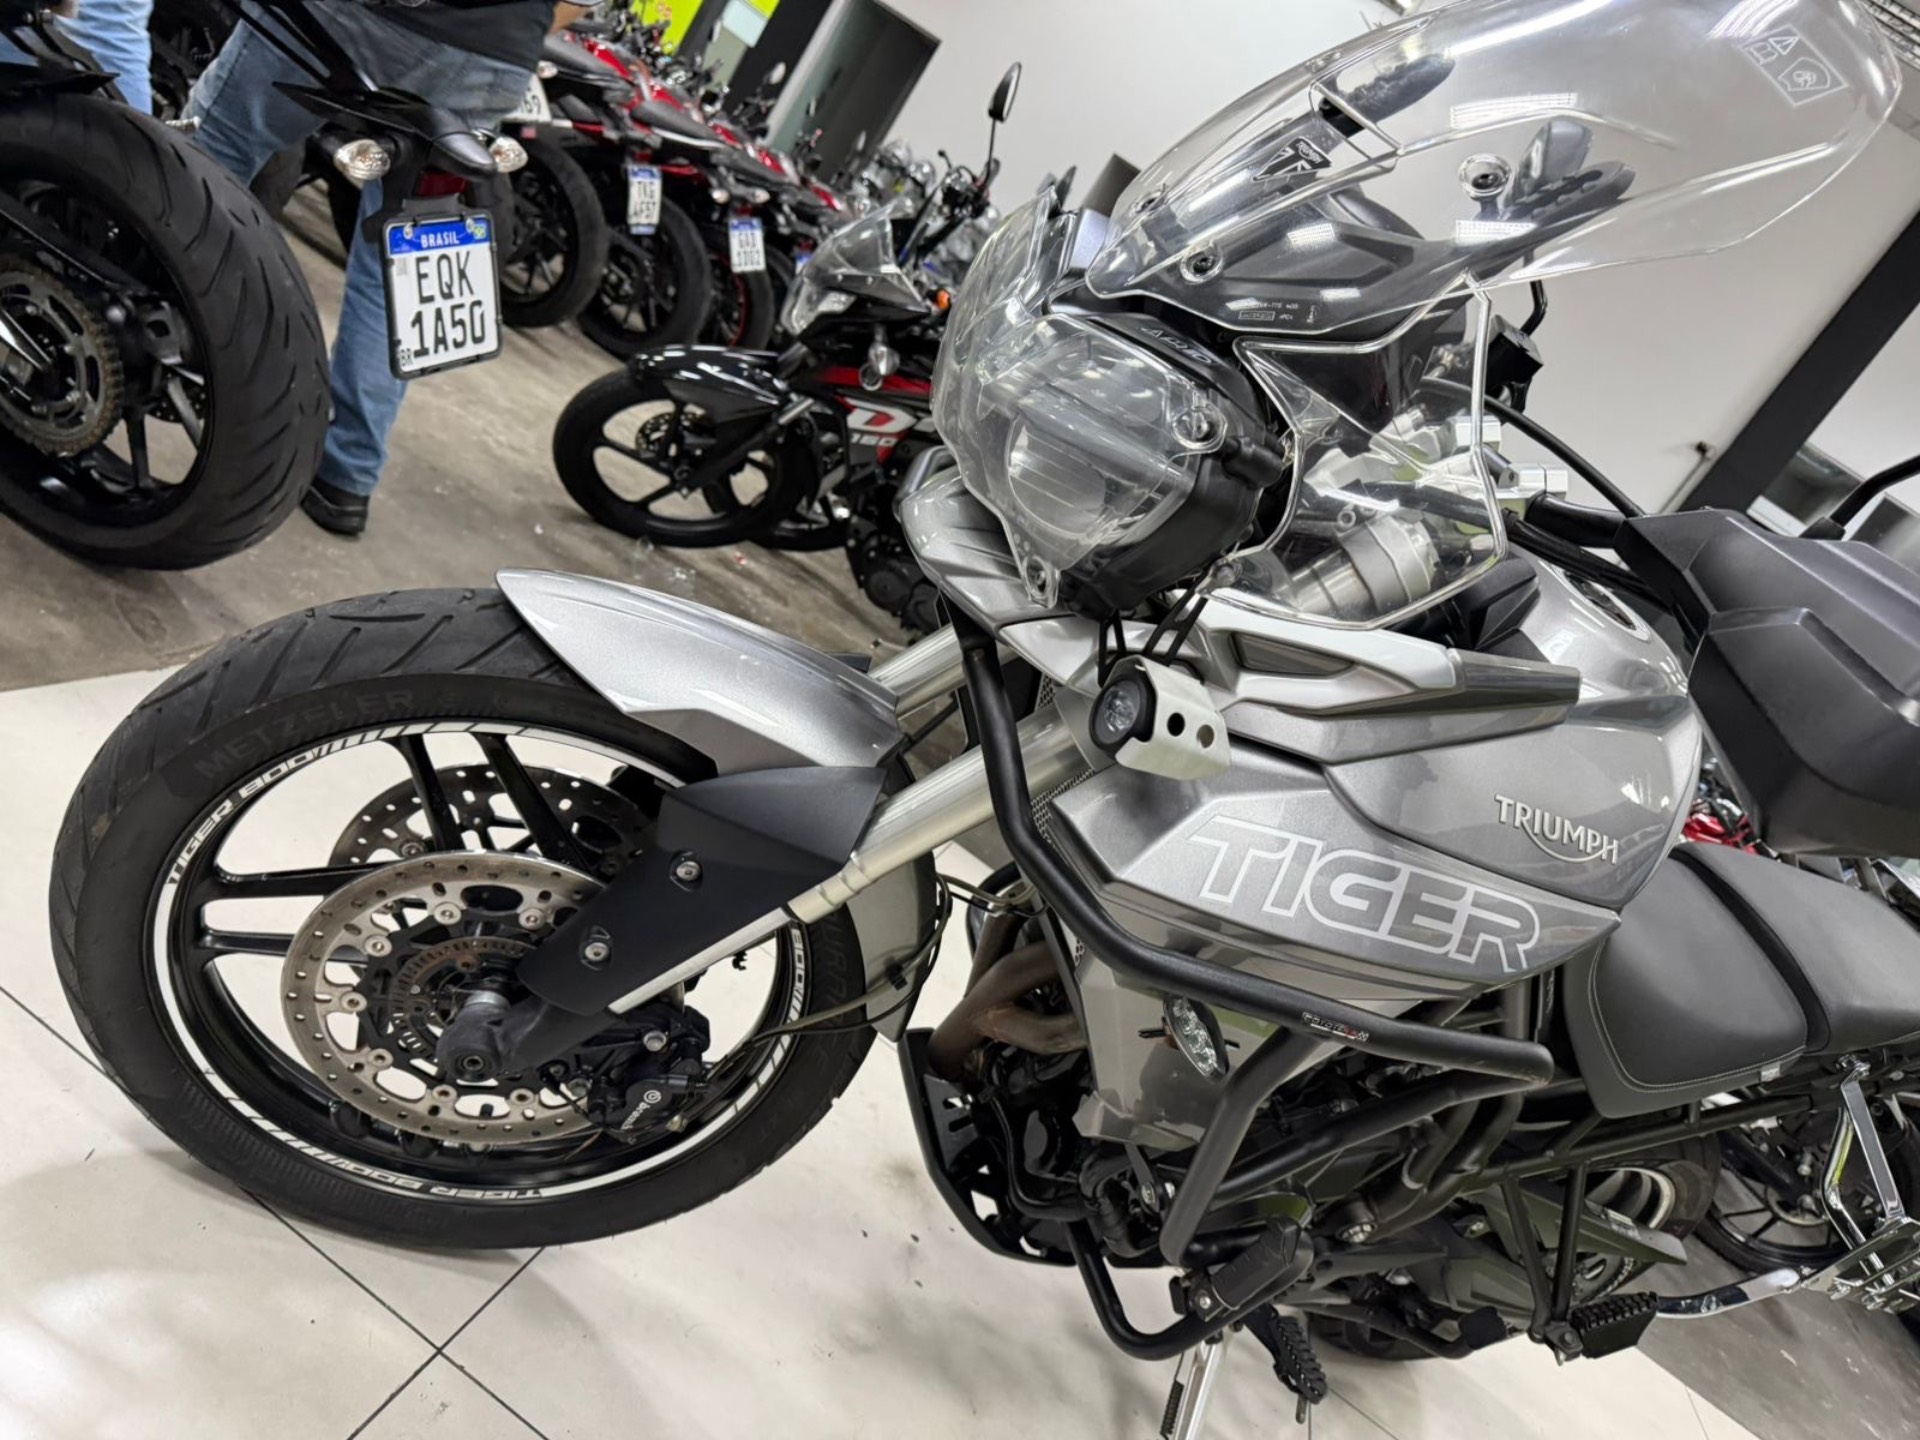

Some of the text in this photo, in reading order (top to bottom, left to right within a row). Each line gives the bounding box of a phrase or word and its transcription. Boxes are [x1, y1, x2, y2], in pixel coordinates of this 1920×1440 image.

[420, 230, 460, 249] BRASIL
[415, 250, 475, 305] EQK
[411, 299, 486, 359] 1A50
[194, 687, 417, 781] METZELER
[166, 748, 315, 885] TIGER 800
[1494, 793, 1620, 866] TRIUMPH
[1186, 814, 1542, 975] TIGER
[430, 1185, 542, 1200] TIGER
